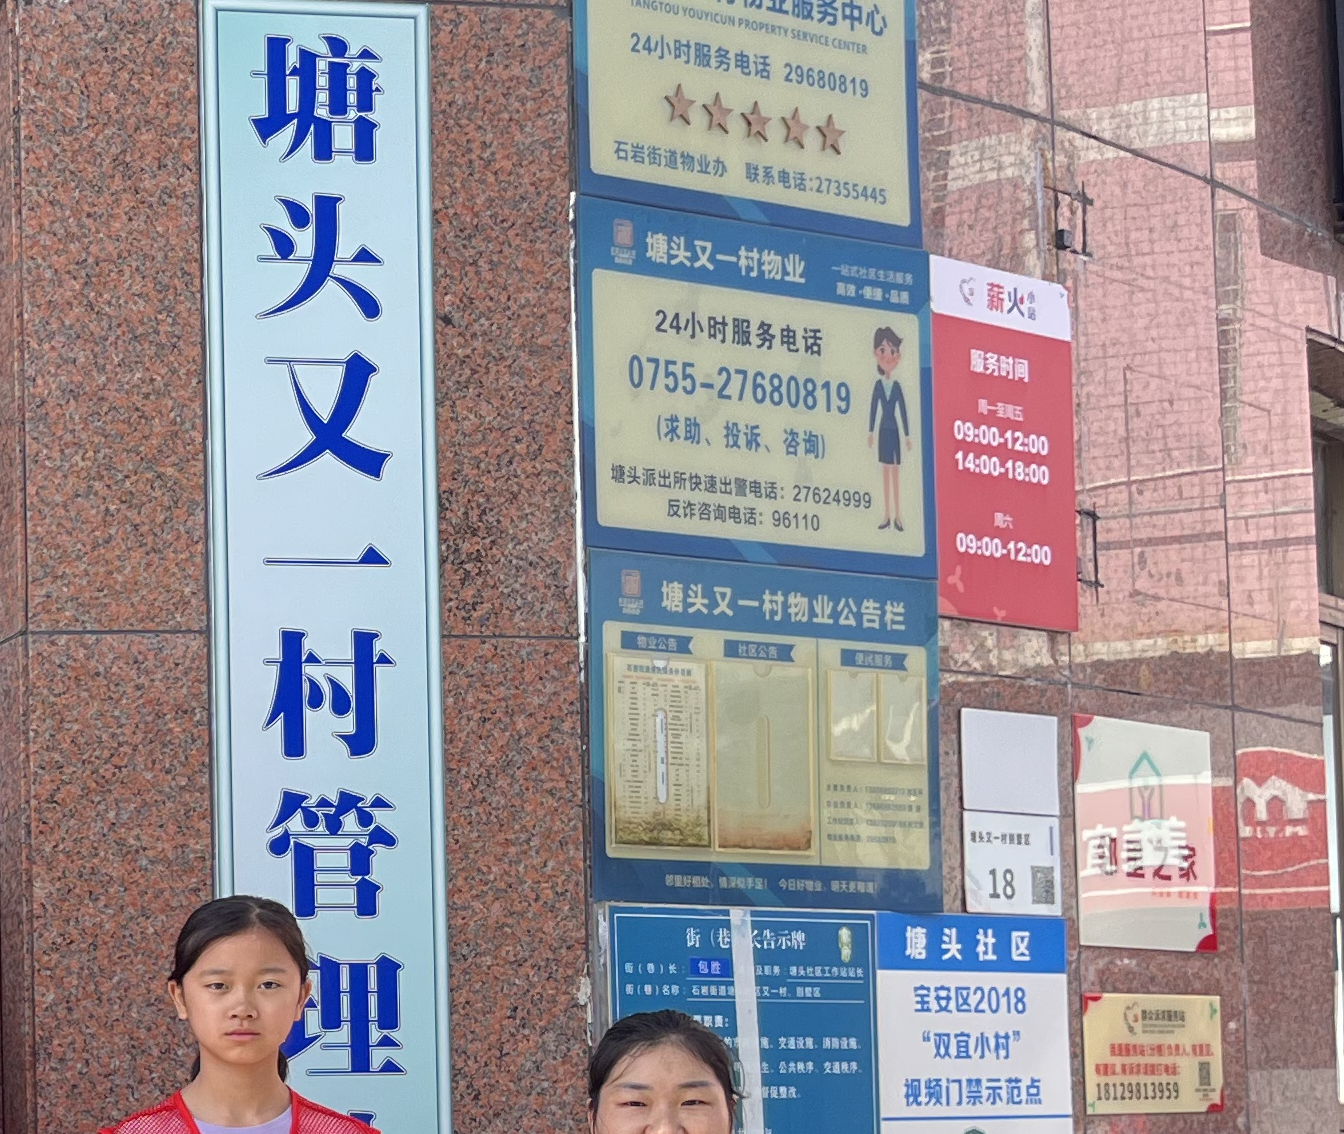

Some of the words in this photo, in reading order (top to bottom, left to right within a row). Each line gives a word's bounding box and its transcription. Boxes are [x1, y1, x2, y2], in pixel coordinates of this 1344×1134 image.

[681, 7, 736, 27] YOUYICUN
[738, 17, 789, 38] PROPERTY
[790, 28, 830, 47] SERVICE
[831, 37, 868, 55] CENTER
[629, 32, 772, 80] 24小时服务电话
[783, 62, 870, 99] 29680819
[613, 139, 728, 178] 石岩街道物业办
[645, 231, 806, 284] 塘头又一村物业
[654, 309, 823, 357] 24小时服务电话
[969, 348, 1029, 383] 服务时间
[627, 354, 851, 415] 0755-27680819
[953, 420, 1049, 456] 09:00-12:00
[954, 451, 1050, 485] 14:00-18:00
[955, 532, 1052, 567] 09:00-12:00
[660, 580, 906, 632] 塘头又一村物业公告栏
[988, 867, 1016, 901] 18
[904, 924, 1032, 963] 塘头社区
[912, 984, 1027, 1016] 宝安区2018
[903, 1077, 1043, 1108] 视频门禁示范点
[1096, 1081, 1180, 1101] 18129813959
